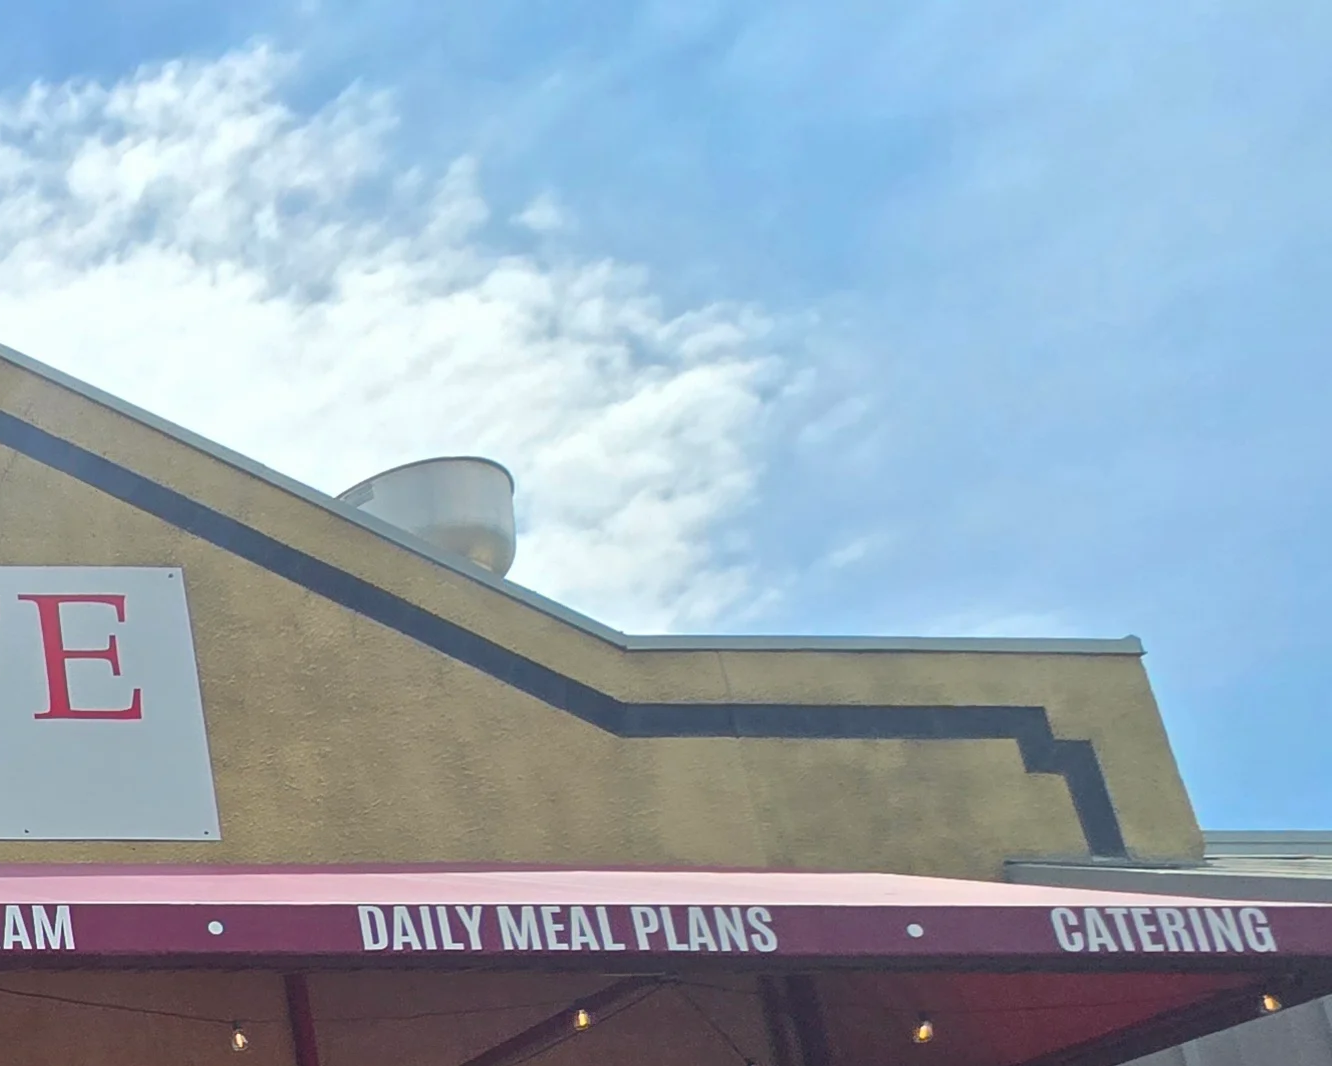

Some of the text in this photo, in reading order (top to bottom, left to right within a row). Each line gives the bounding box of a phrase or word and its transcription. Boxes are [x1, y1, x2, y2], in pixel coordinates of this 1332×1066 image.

[357, 905, 778, 952] DAILY MEAL PLANS
[1050, 906, 1277, 953] CATERING
